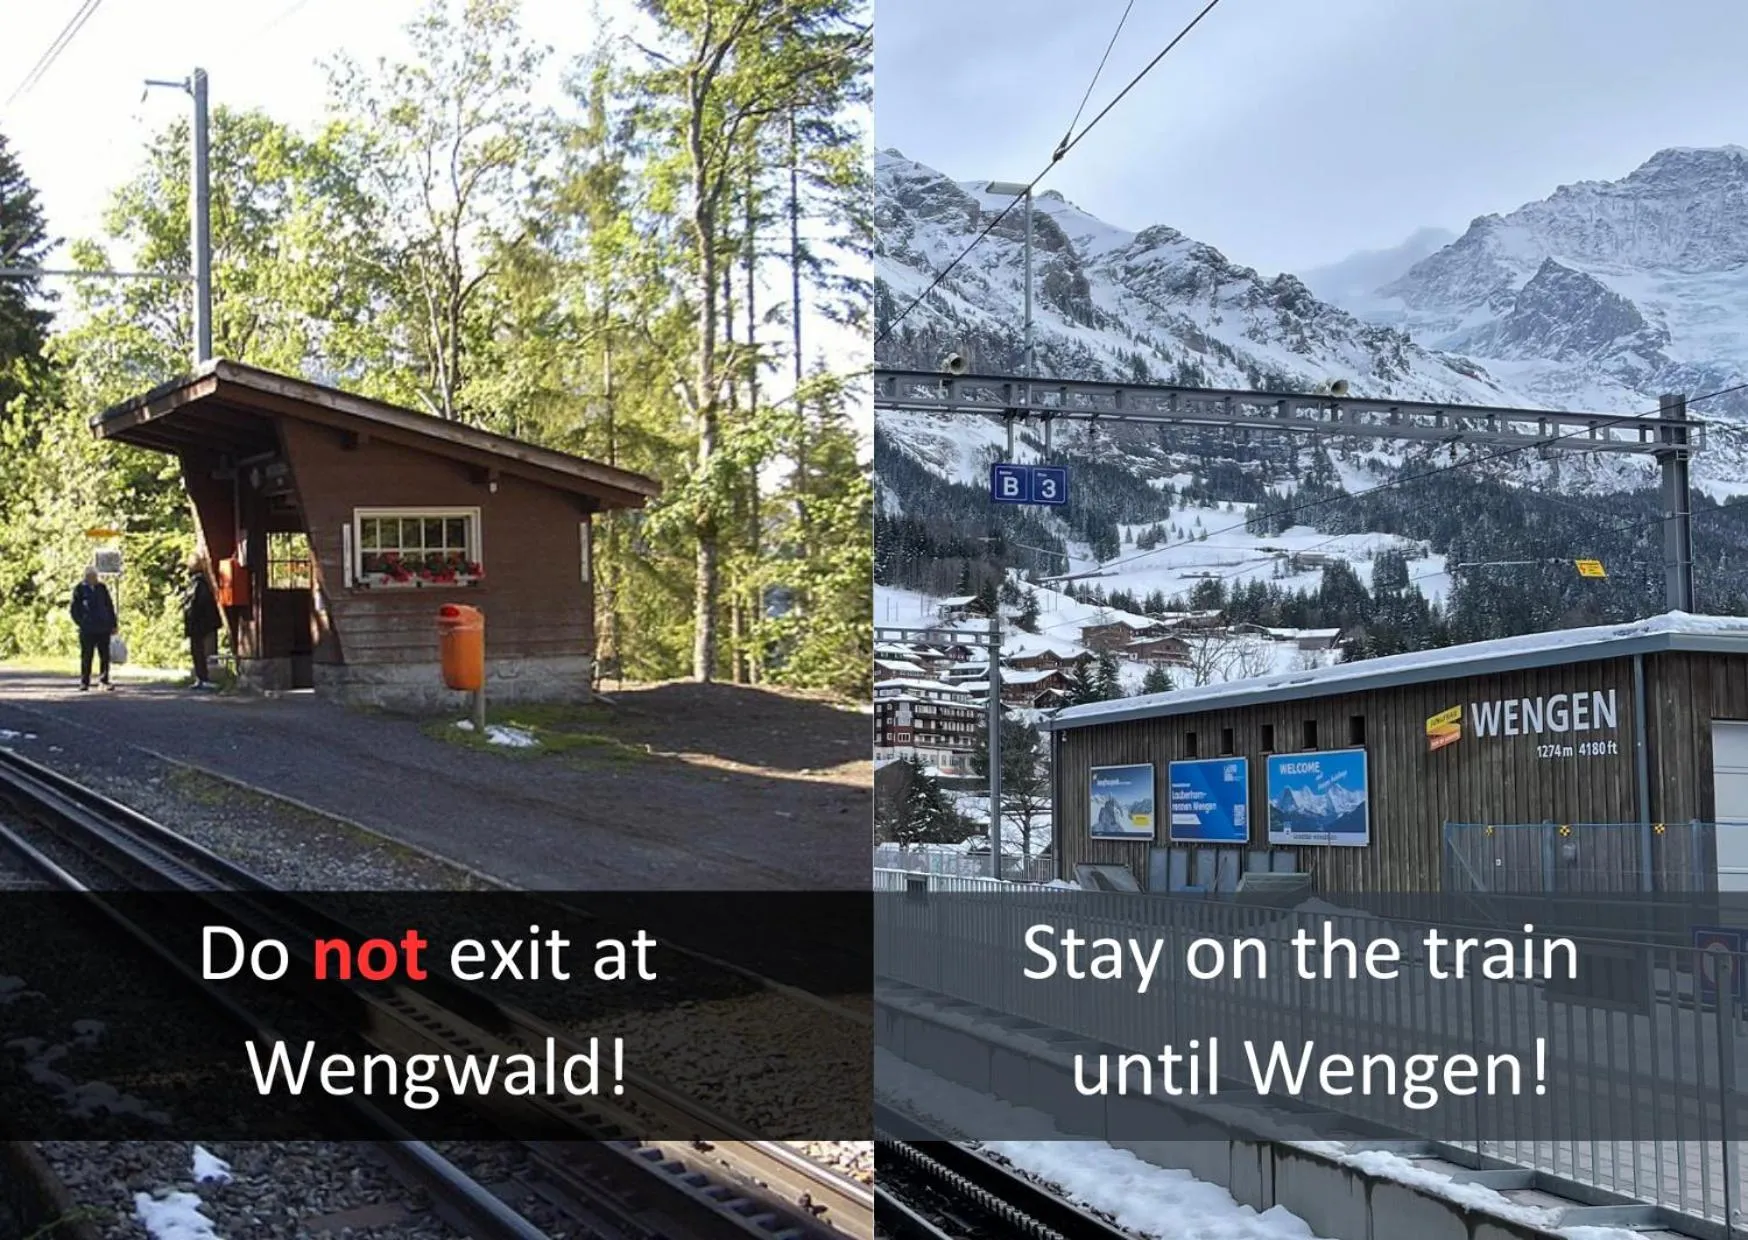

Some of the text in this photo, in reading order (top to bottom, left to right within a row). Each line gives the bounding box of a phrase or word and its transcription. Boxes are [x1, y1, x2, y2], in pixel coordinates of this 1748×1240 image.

[1003, 476, 1057, 499] B 3
[1471, 689, 1617, 738] WENGEN
[1280, 762, 1321, 775] WELCOME
[1193, 801, 1217, 814] Wengen
